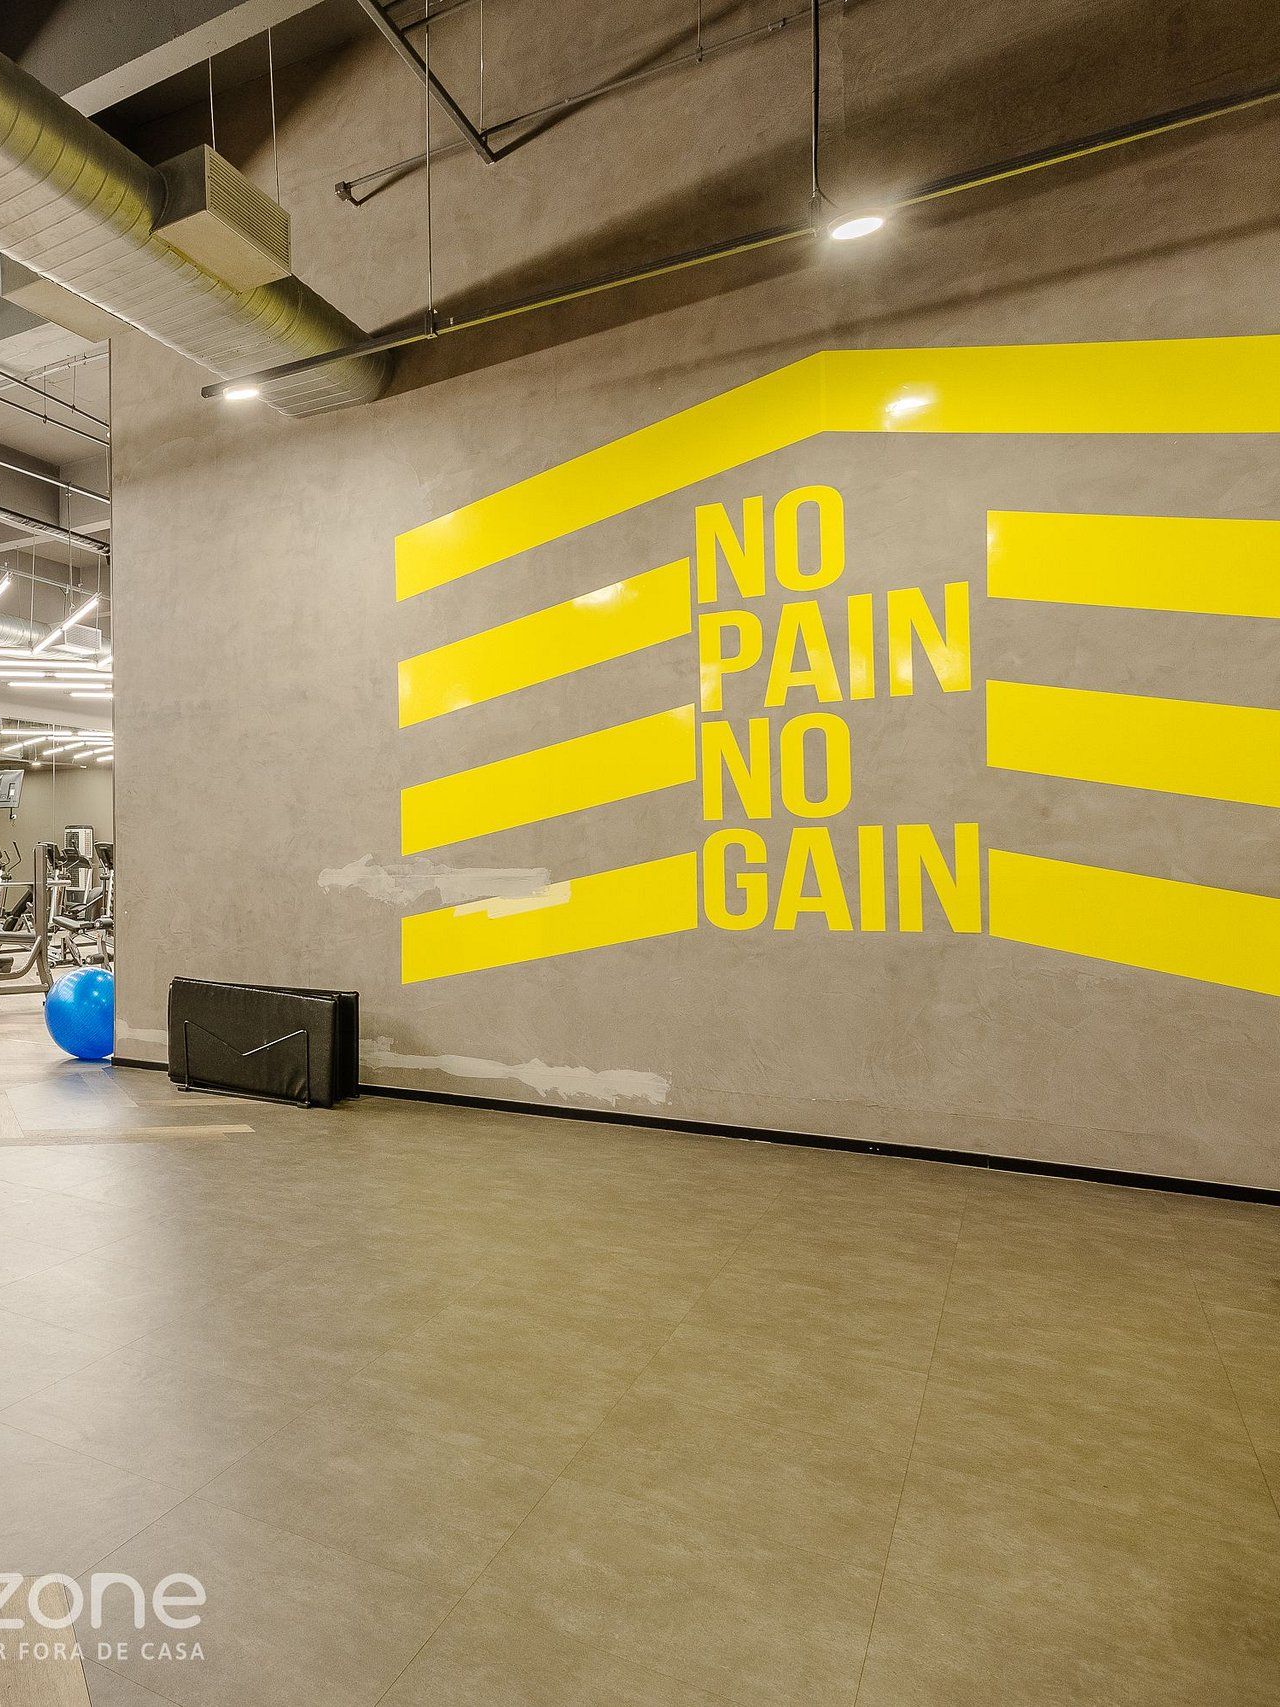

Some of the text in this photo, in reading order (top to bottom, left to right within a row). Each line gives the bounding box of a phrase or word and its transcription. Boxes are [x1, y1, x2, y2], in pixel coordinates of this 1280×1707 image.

[695, 484, 846, 604] NO
[698, 580, 972, 713] PAIN
[701, 712, 853, 821] NO
[702, 822, 983, 934] GAIN
